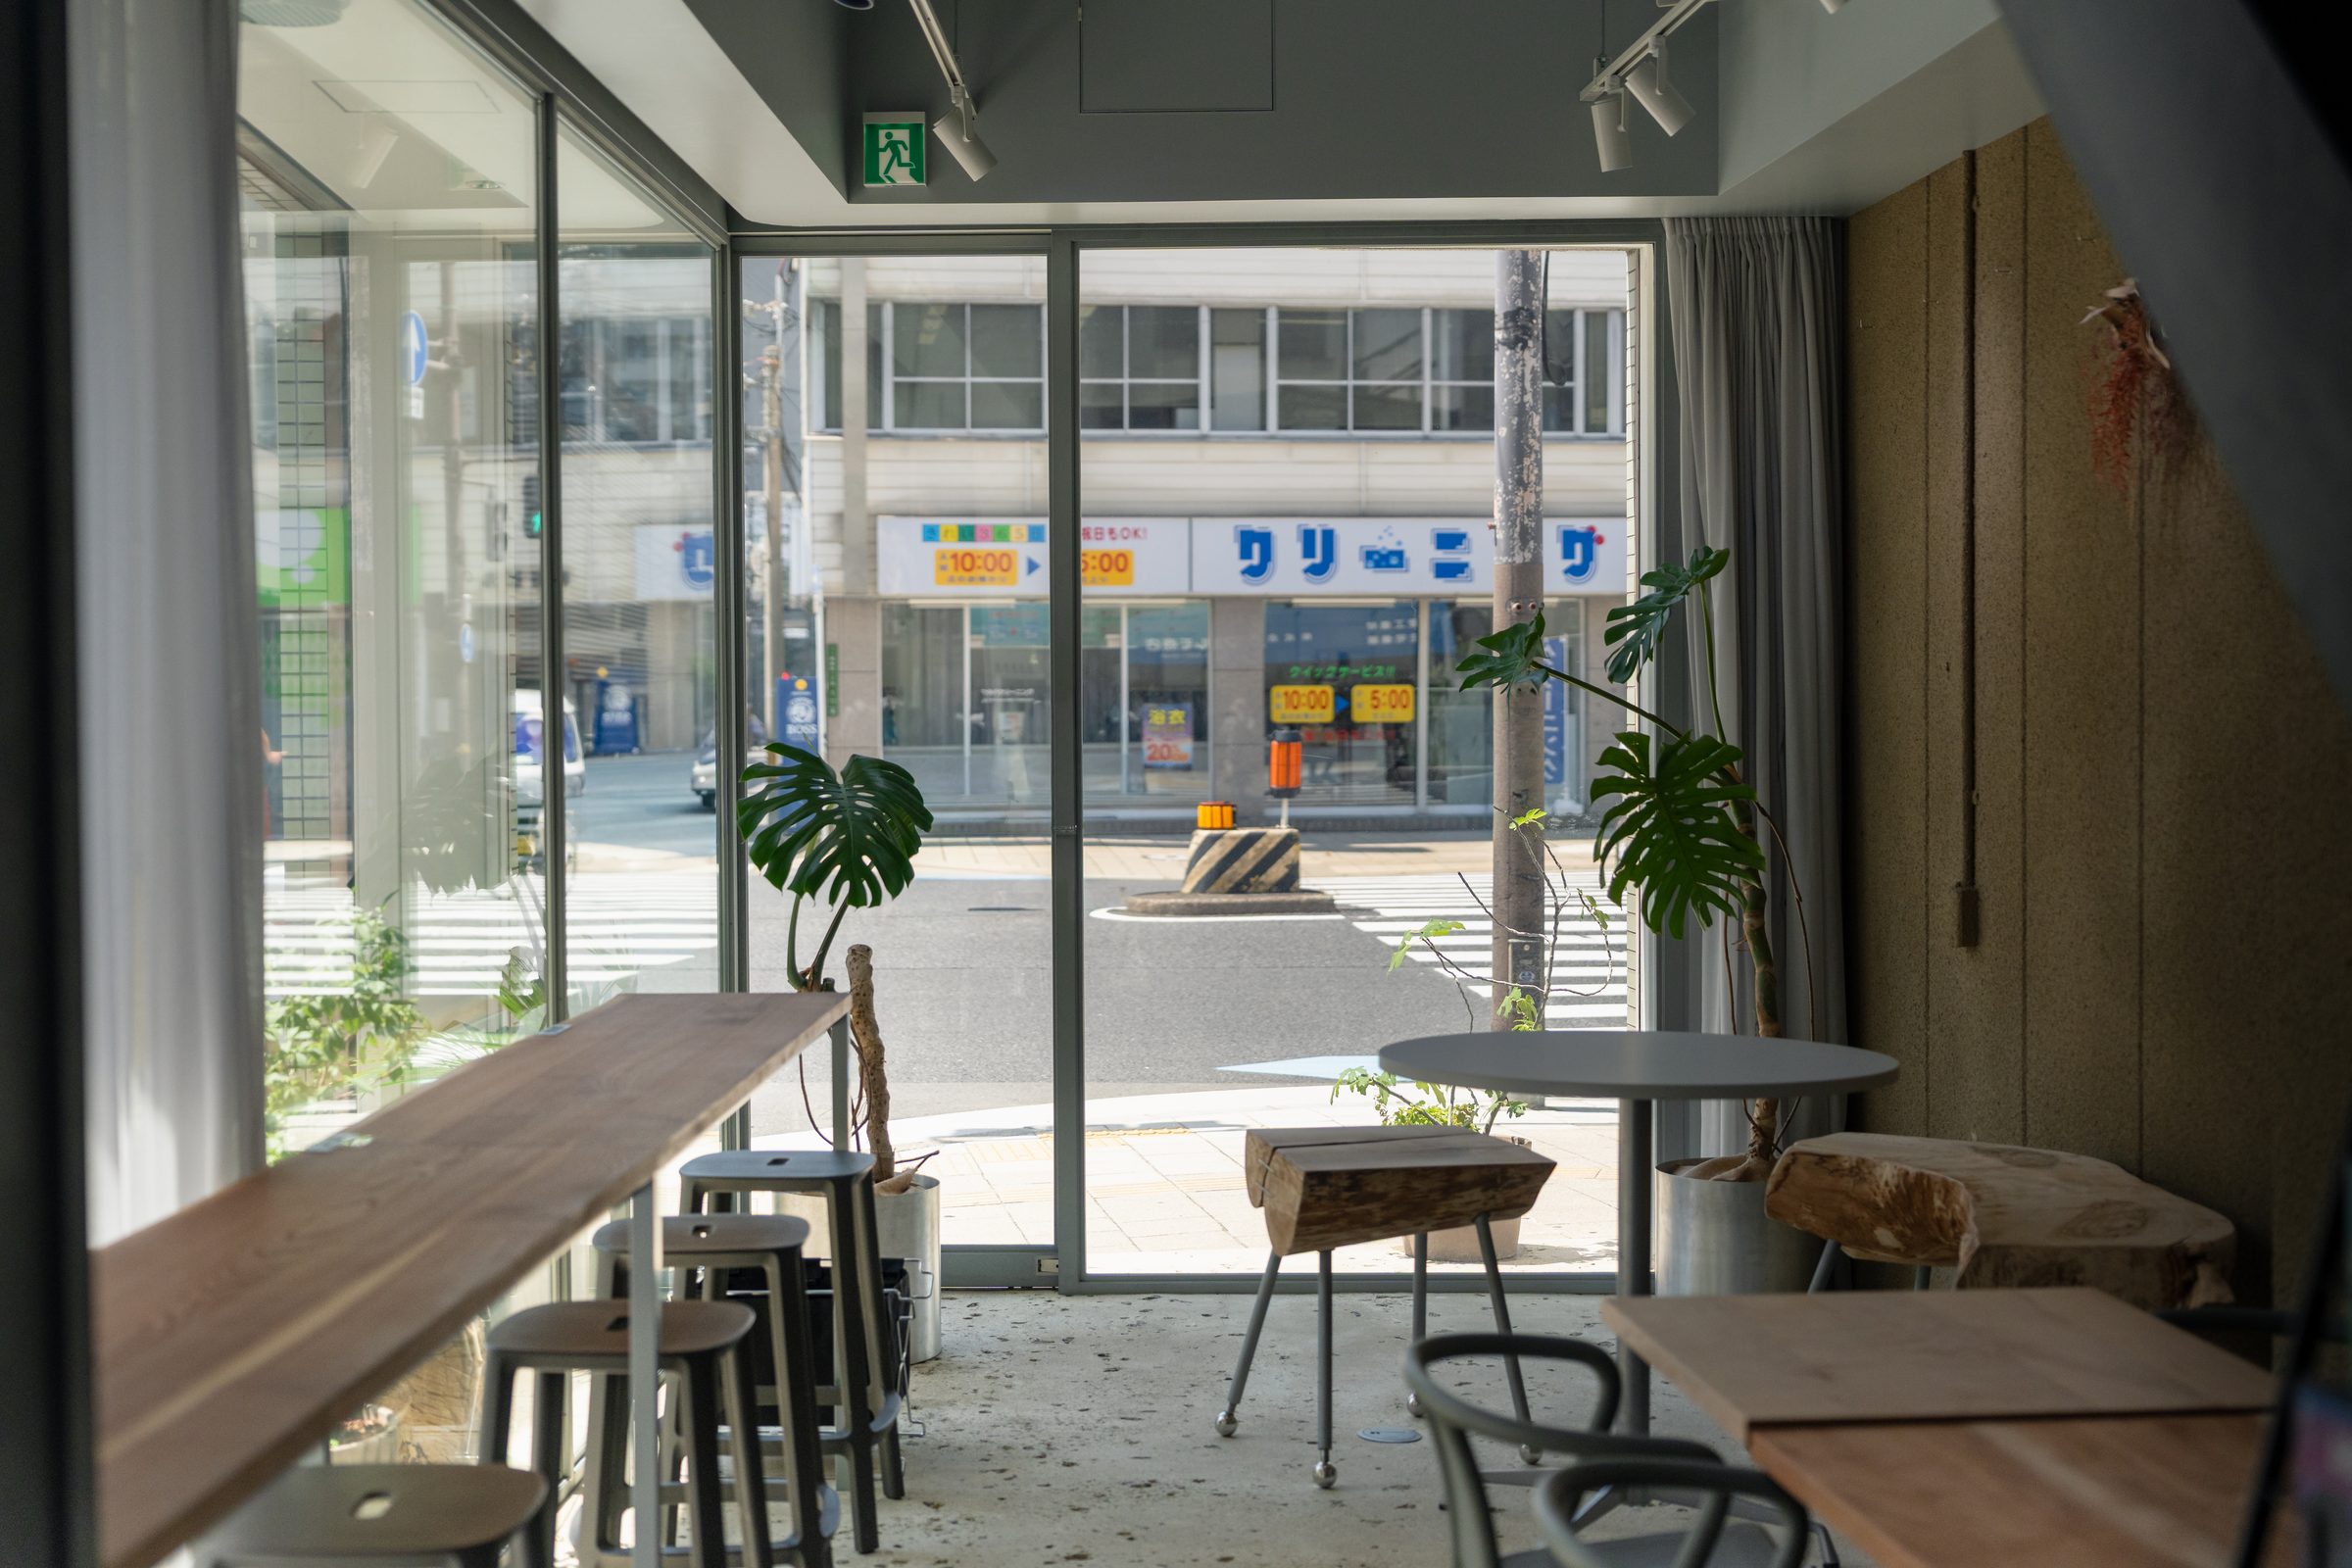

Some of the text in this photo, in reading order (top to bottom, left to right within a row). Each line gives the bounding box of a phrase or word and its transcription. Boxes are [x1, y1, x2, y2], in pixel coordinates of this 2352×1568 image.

[950, 552, 1013, 573] 10:00
[1283, 689, 1330, 710] 10:00
[1370, 689, 1411, 710] 5:00
[1149, 709, 1187, 725] 浴衣
[786, 723, 817, 735] BOSS
